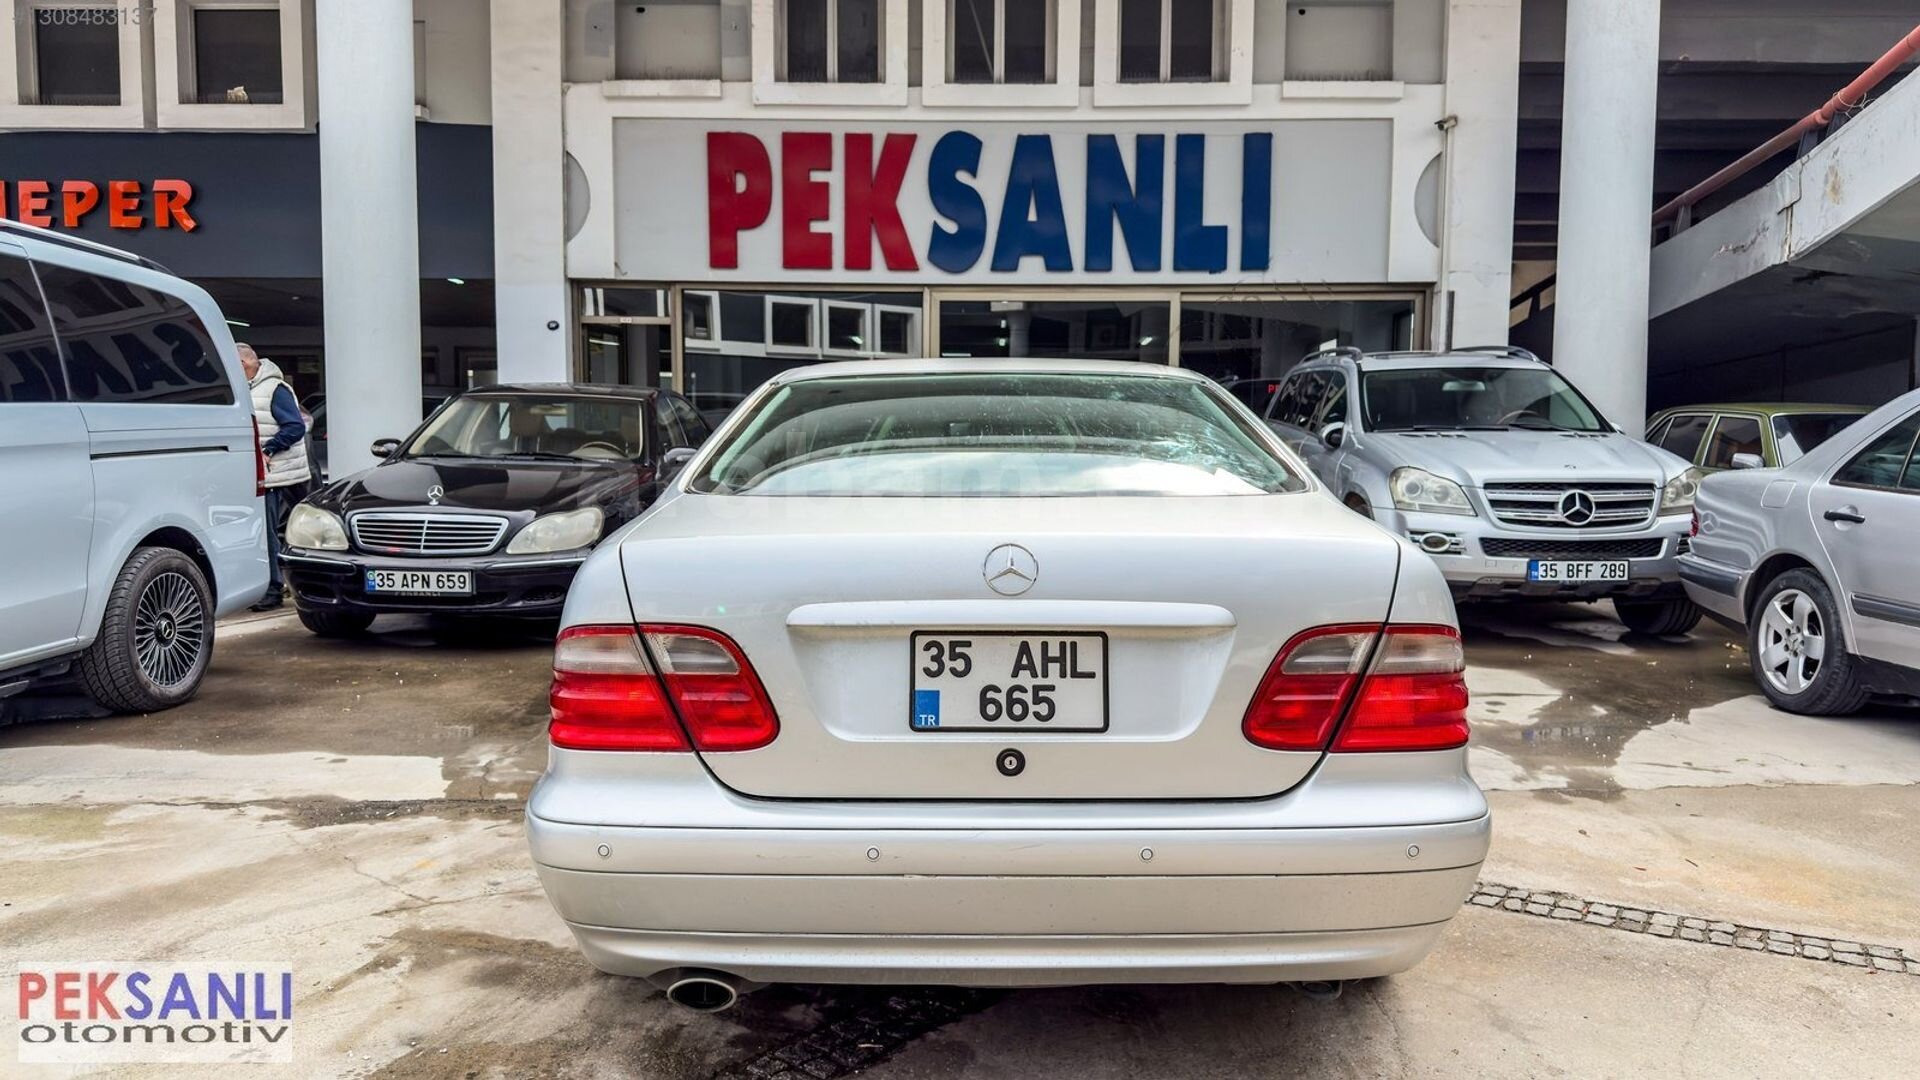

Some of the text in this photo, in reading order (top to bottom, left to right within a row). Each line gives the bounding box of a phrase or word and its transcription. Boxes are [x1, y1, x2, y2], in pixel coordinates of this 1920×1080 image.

[707, 130, 1273, 273] PEKSANLI
[376, 572, 467, 589] 35 APN 659
[1540, 563, 1626, 579] 35 BFF 289
[922, 640, 1097, 679] 35 AHL
[979, 684, 1056, 722] 665
[919, 714, 936, 726] TR
